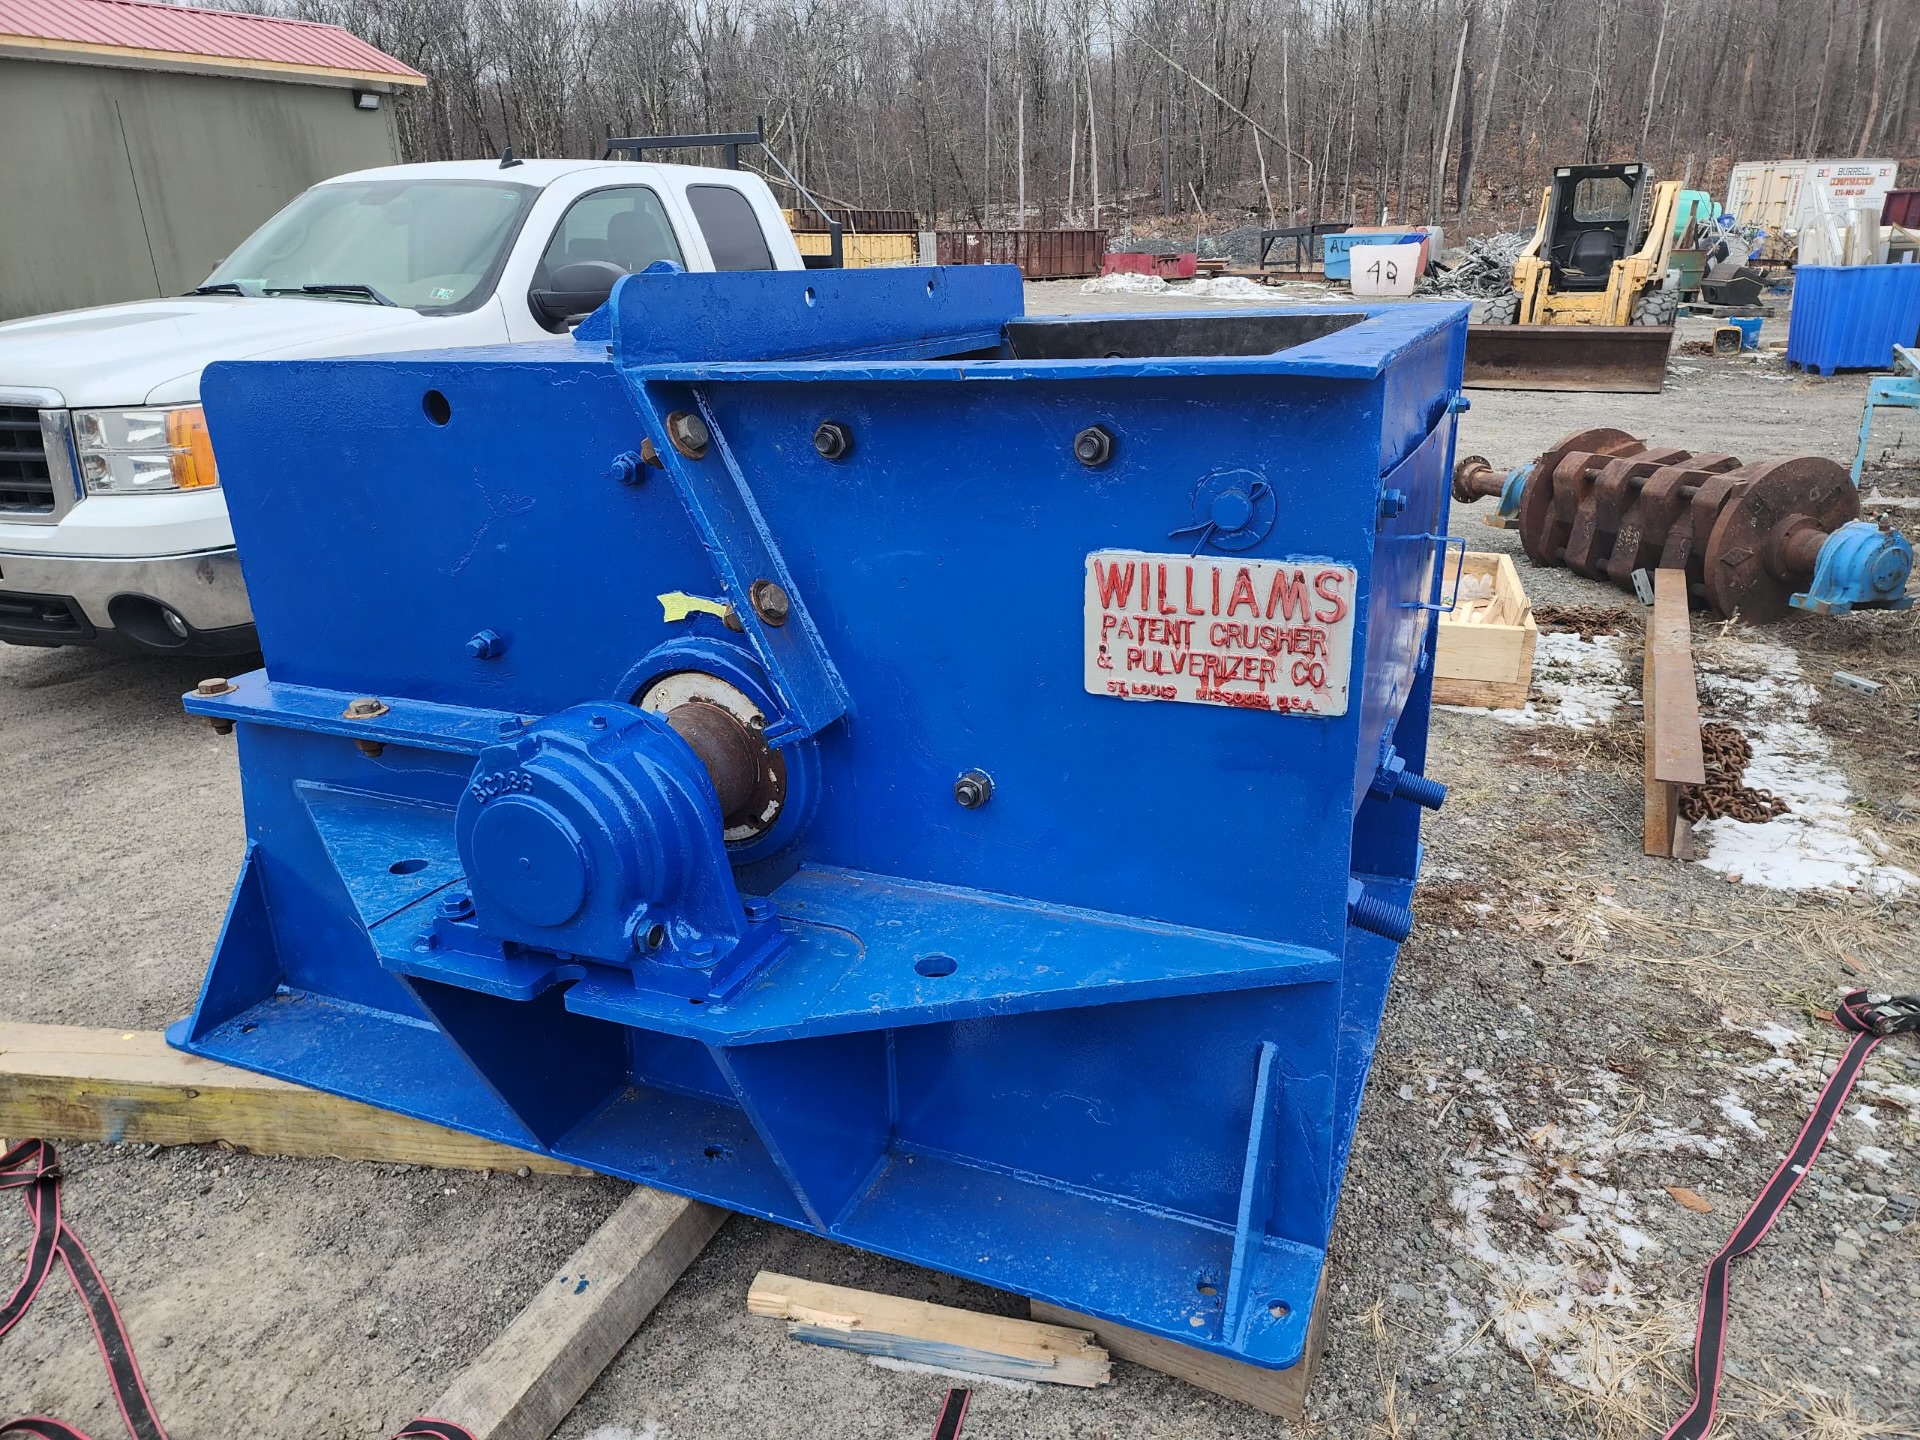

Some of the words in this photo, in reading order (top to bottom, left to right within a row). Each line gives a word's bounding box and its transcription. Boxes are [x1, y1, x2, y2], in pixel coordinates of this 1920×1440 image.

[1837, 167, 1872, 175] BURRELL
[1094, 559, 1347, 623] WILLIAMS
[1102, 613, 1196, 650] PATENT
[1209, 620, 1327, 655] CRUSHER
[1096, 643, 1113, 669] &
[1127, 647, 1277, 683] PULVERIZER
[1132, 681, 1177, 699] LOUIS
